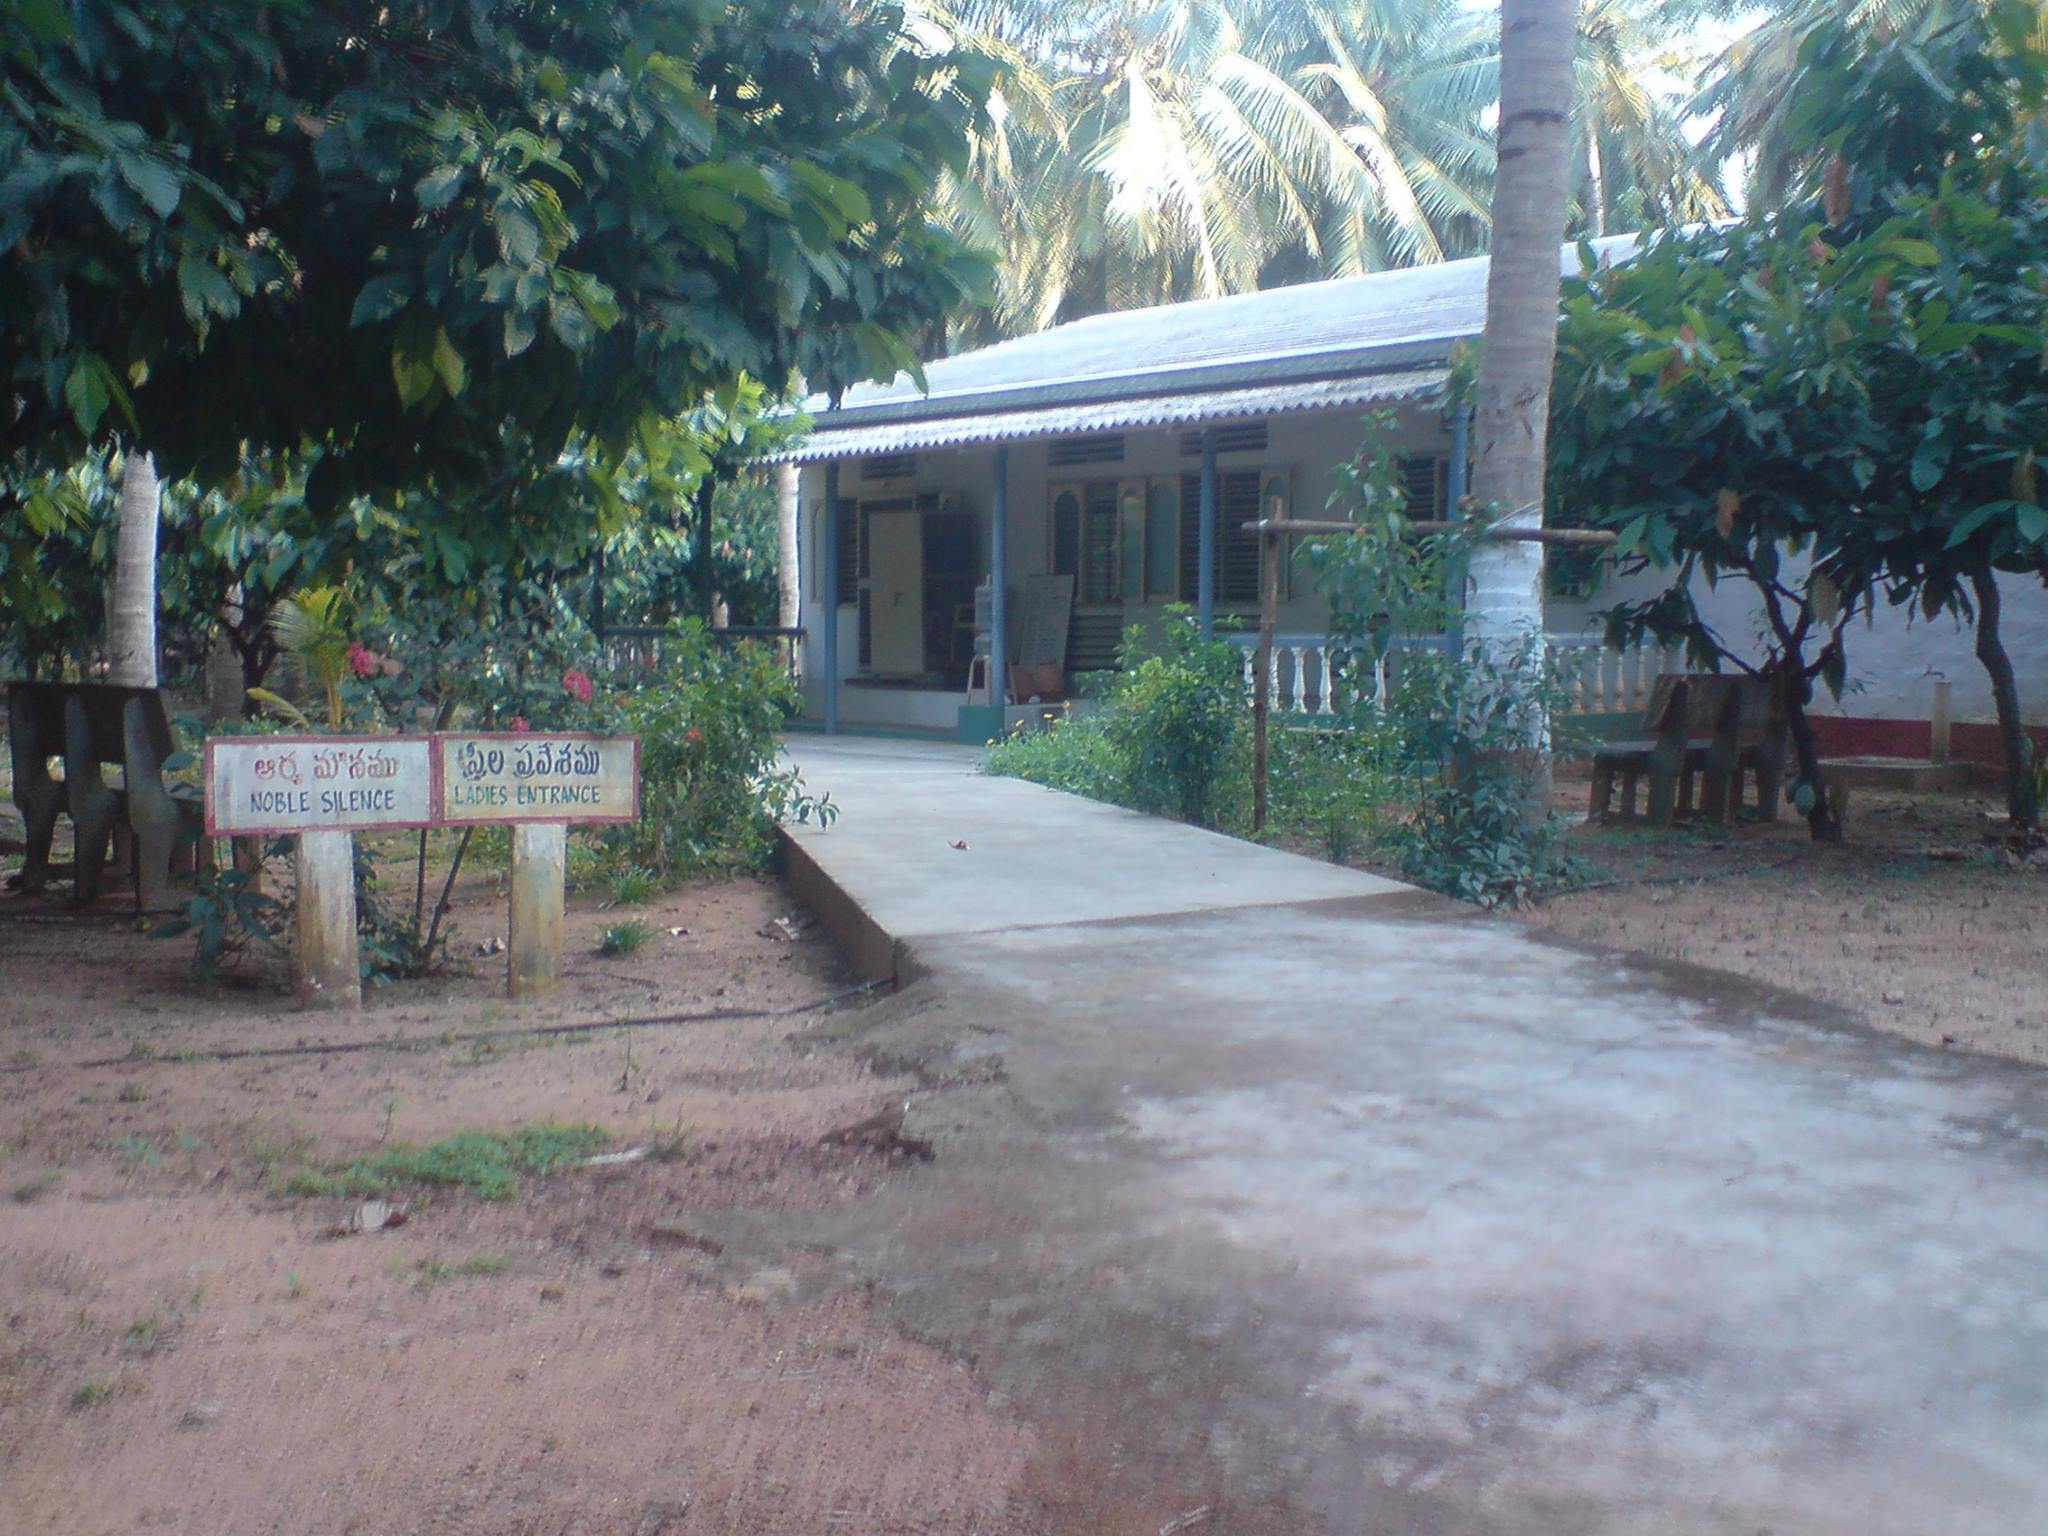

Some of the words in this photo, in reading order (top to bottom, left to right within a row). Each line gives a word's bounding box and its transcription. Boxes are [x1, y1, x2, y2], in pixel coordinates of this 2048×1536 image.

[513, 742, 600, 780] ప్రవేశము
[251, 791, 311, 813] NOBLE
[321, 789, 396, 813] SILENCE
[454, 785, 508, 805] LADIES
[516, 785, 601, 805] ENTRANCE
